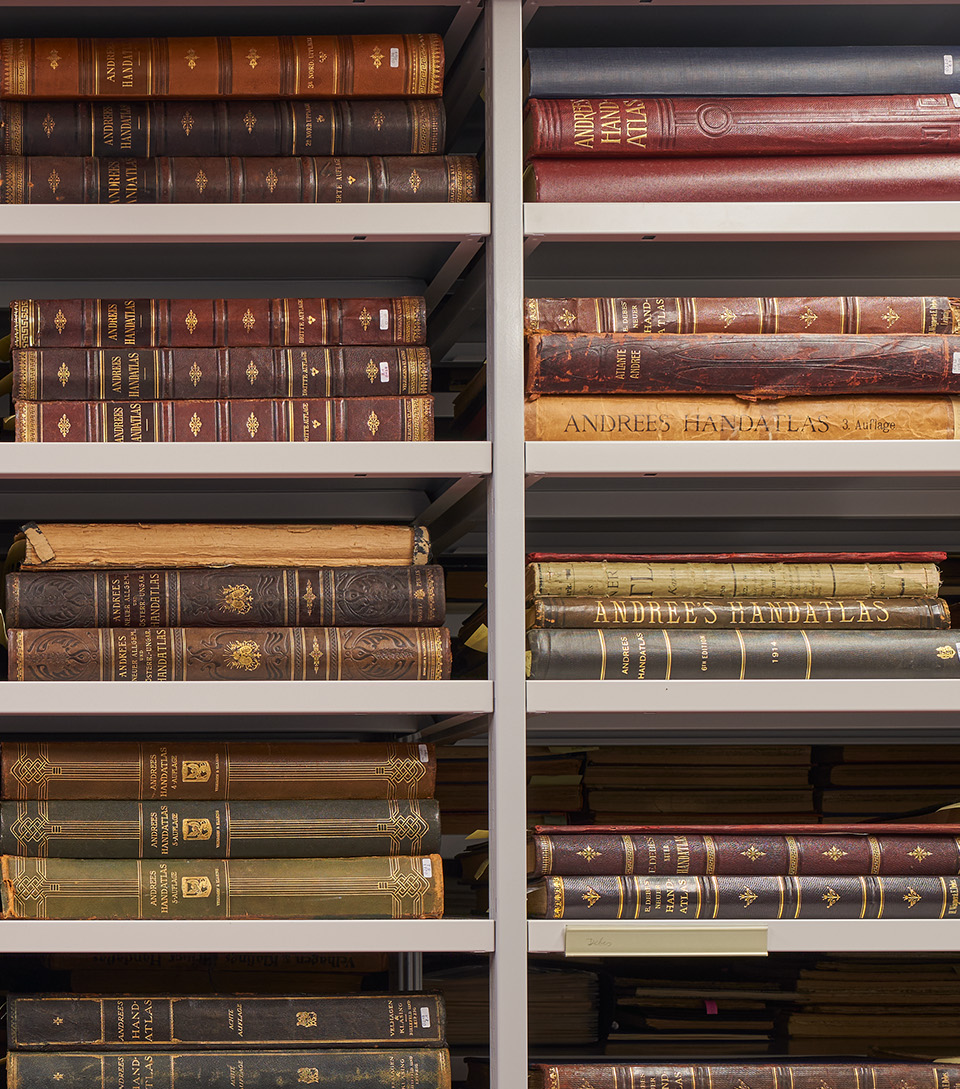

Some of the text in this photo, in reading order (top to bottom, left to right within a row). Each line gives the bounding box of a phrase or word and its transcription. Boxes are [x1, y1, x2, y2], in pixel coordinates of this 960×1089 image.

[623, 100, 647, 148] ATLAS
[108, 304, 118, 340] ANDREES
[125, 301, 135, 345] HANDATLAS
[113, 356, 122, 393] ANDREES
[128, 353, 140, 397] HANDATLAS
[616, 349, 627, 380] ATLANTE
[630, 350, 640, 379] ANDREE
[564, 414, 896, 434] ANDREES HANDATLAS 3. Auflage
[112, 579, 120, 621] ANDREES
[594, 601, 890, 624] ANDREE'S HANDATLAS
[119, 635, 128, 677] ANDREES
[621, 636, 629, 675] ANDREES
[637, 633, 648, 679] HANDATLAS
[160, 864, 168, 913] HANDATLAS
[679, 879, 688, 914] ATLAS
[144, 1000, 153, 1042] ATLAS
